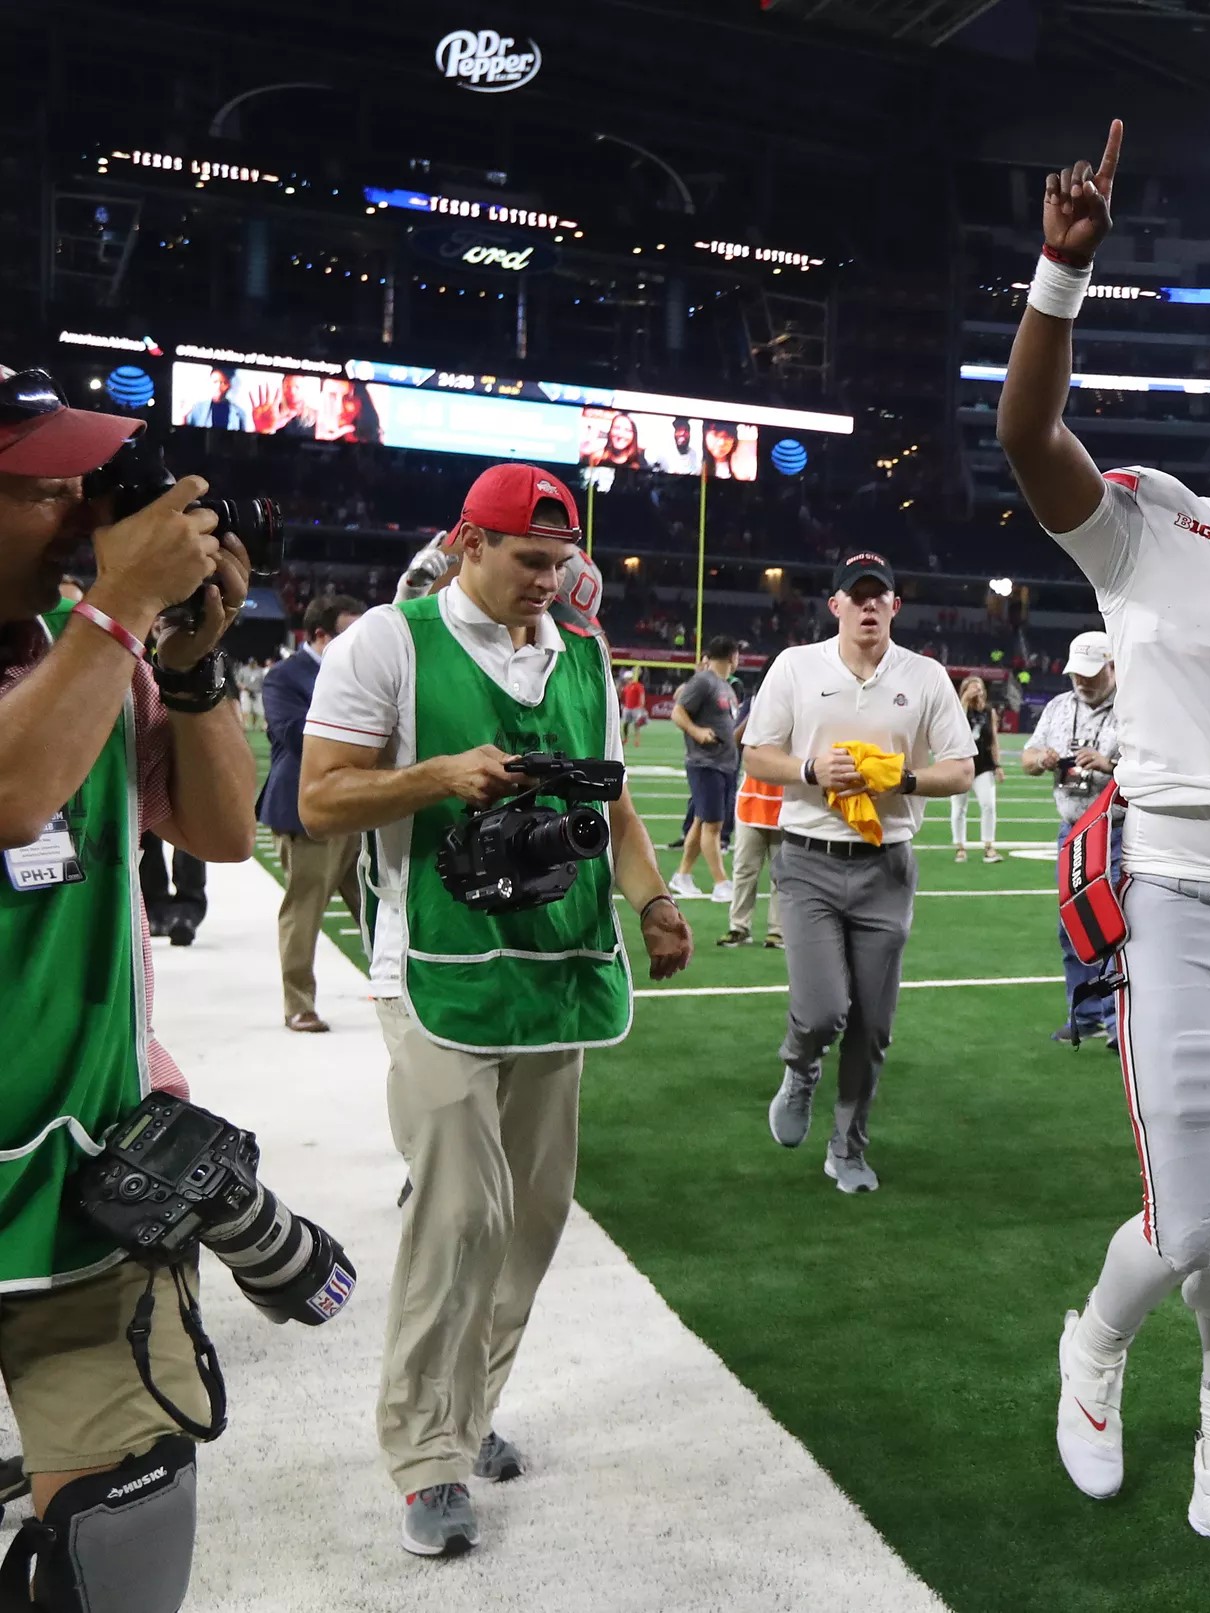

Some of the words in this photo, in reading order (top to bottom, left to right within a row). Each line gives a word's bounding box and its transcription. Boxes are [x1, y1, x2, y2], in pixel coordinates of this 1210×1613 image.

[435, 29, 535, 83] Pepper
[475, 29, 515, 57] Dr
[1071, 832, 1083, 890] DOUGLAS
[122, 1466, 164, 1494] HUSKY
